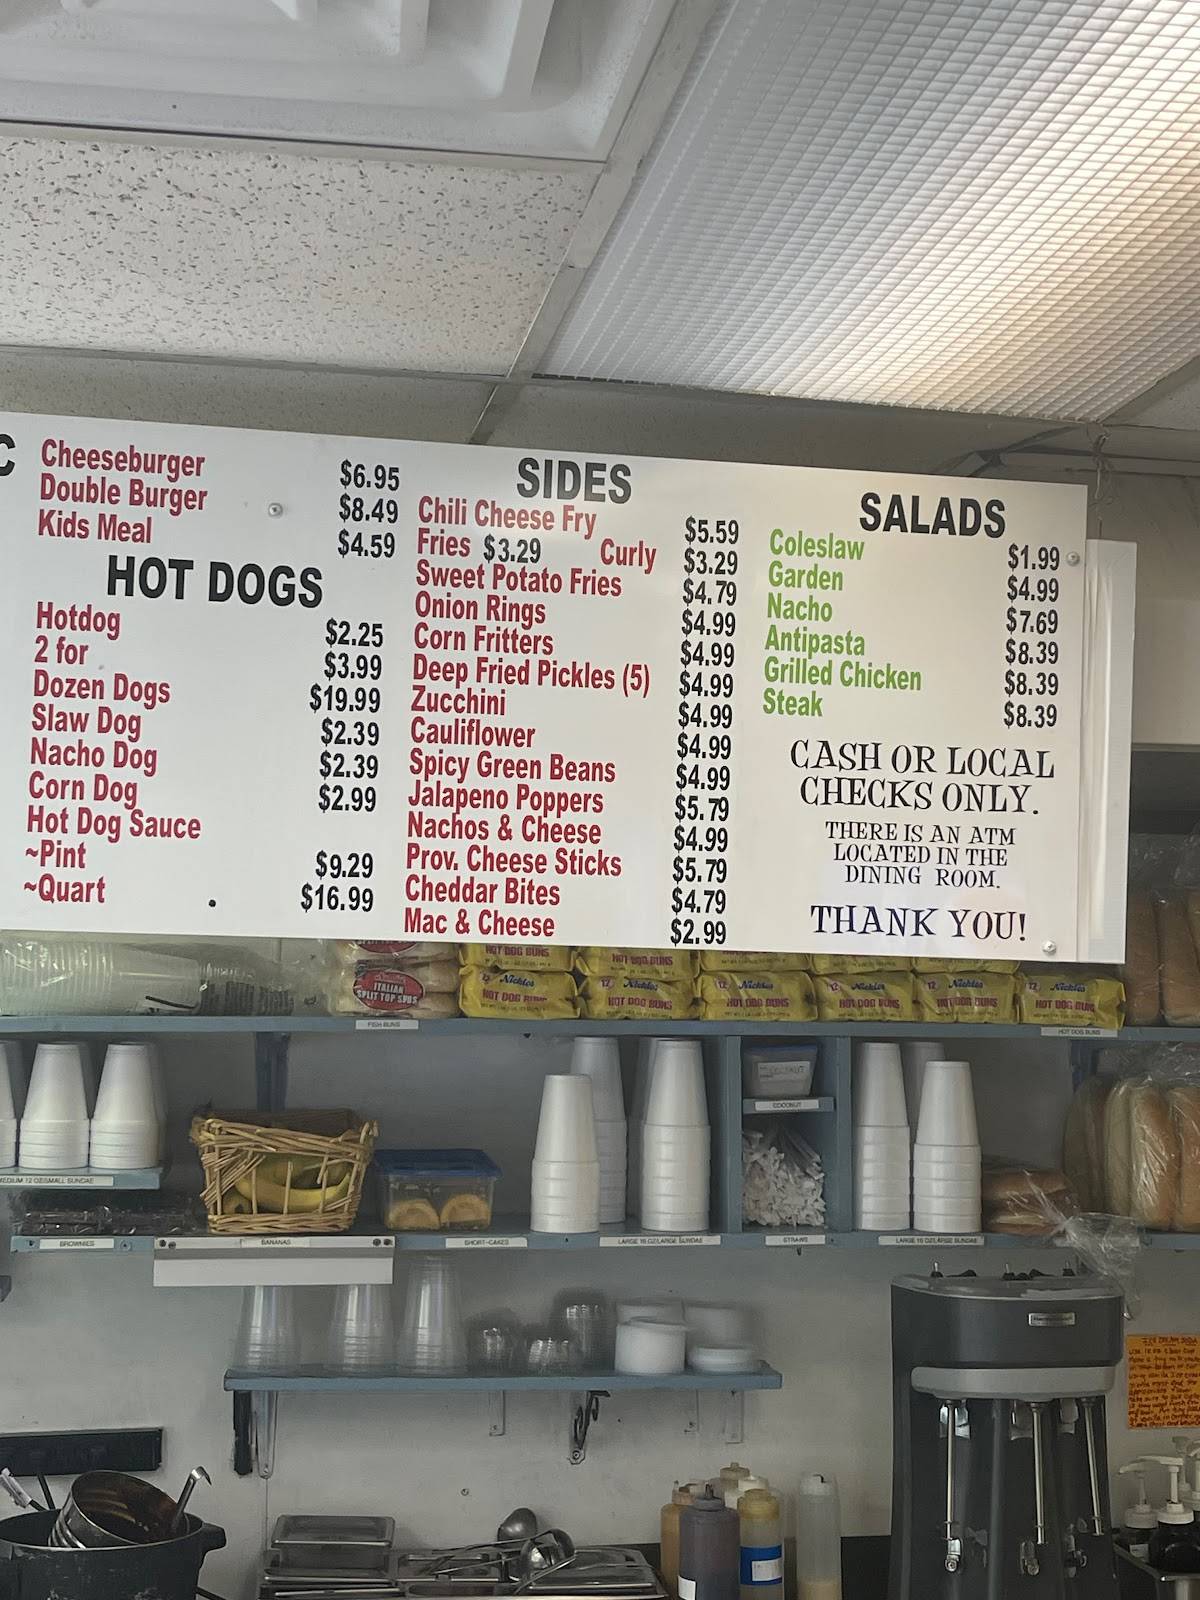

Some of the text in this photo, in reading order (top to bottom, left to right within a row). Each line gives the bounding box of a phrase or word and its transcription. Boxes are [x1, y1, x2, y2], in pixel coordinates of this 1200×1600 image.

[41, 439, 205, 482] Cheeseburger
[340, 459, 399, 491] $6.95
[41, 473, 207, 516] Double Burger
[517, 458, 631, 504] SIDES
[339, 493, 398, 523] $8.49
[419, 496, 596, 539] Chili Cheese Fry
[860, 492, 1005, 538] SALADS
[39, 509, 151, 543] Kids Meal
[685, 516, 739, 545] $5.59
[338, 528, 395, 558] $4.59
[418, 528, 541, 563] Fries $3.29
[601, 539, 656, 574] Curly
[770, 529, 864, 560] Coleslaw
[1008, 543, 1059, 571] $1.99
[684, 547, 738, 575] $3.29
[769, 561, 842, 590] Garden
[107, 555, 322, 608] HOT DOGS
[416, 559, 621, 596] Sweet Potato Fries
[683, 578, 736, 606] $4.79
[1007, 575, 1059, 602] $4.99
[37, 601, 120, 640] Hotdog
[416, 591, 545, 630] Onion Rings
[682, 608, 735, 637] $4.99
[768, 593, 832, 622] Nacho
[1006, 606, 1058, 635] $7.69
[326, 618, 383, 648] $2.25
[414, 622, 553, 655] Corn Fritters
[765, 625, 864, 659] Antipasta
[34, 635, 88, 664] 2 for
[680, 639, 734, 668] $4.99
[1005, 638, 1058, 665] $8.39
[324, 651, 382, 681] $3.99
[414, 653, 649, 698] Deep Fried Pickles (5)
[765, 656, 921, 690] Grilled Chicken
[34, 669, 170, 710] Dozen Dogs
[310, 683, 380, 713] $19.99
[679, 670, 733, 698] $4.99
[1004, 669, 1058, 697] $8.39
[411, 685, 505, 715] Zucchini
[763, 688, 822, 716] Steak
[1004, 700, 1057, 729] $8.39
[32, 703, 141, 743] Slaw Dog
[678, 701, 732, 730] $4.99
[321, 717, 379, 747] $2.39
[411, 716, 535, 747] Cauliflower
[677, 732, 731, 760] $4.99
[31, 737, 157, 777] Nacho Dog
[320, 750, 378, 780] $2.39
[410, 748, 615, 784] Spicy Green Beans
[791, 740, 1054, 778] CASH OR LOCAL
[29, 771, 137, 810] Corn Dog
[676, 763, 730, 791] $4.99
[319, 783, 376, 813] $2.99
[408, 780, 603, 818] Jalapeno Poppers
[675, 794, 729, 822] $5.79
[801, 776, 1038, 814] CHECKS ONLY.
[28, 805, 200, 843] Hot Dog Sauce
[408, 811, 601, 844] Nachos & Cheese
[674, 825, 728, 853] $4.99
[826, 821, 1015, 845] THERE IS AN ATM
[316, 850, 373, 880] $9.29
[407, 843, 621, 876] Prov. Cheese Sticks
[673, 855, 727, 884] $5.79
[834, 843, 1007, 866] LOCATED IN THE
[406, 874, 560, 905] Cheddar Bites
[846, 865, 1000, 888] DINING ROOM.
[301, 883, 373, 912] $16.99
[671, 886, 726, 915] $4.79
[405, 907, 554, 937] Mac & Cheese
[670, 918, 726, 947] $2.99
[811, 905, 1025, 941] THANK YOU!
[356, 990, 378, 1000] SPLIT
[380, 992, 395, 1002] TOP
[373, 982, 404, 993] ITALIAN
